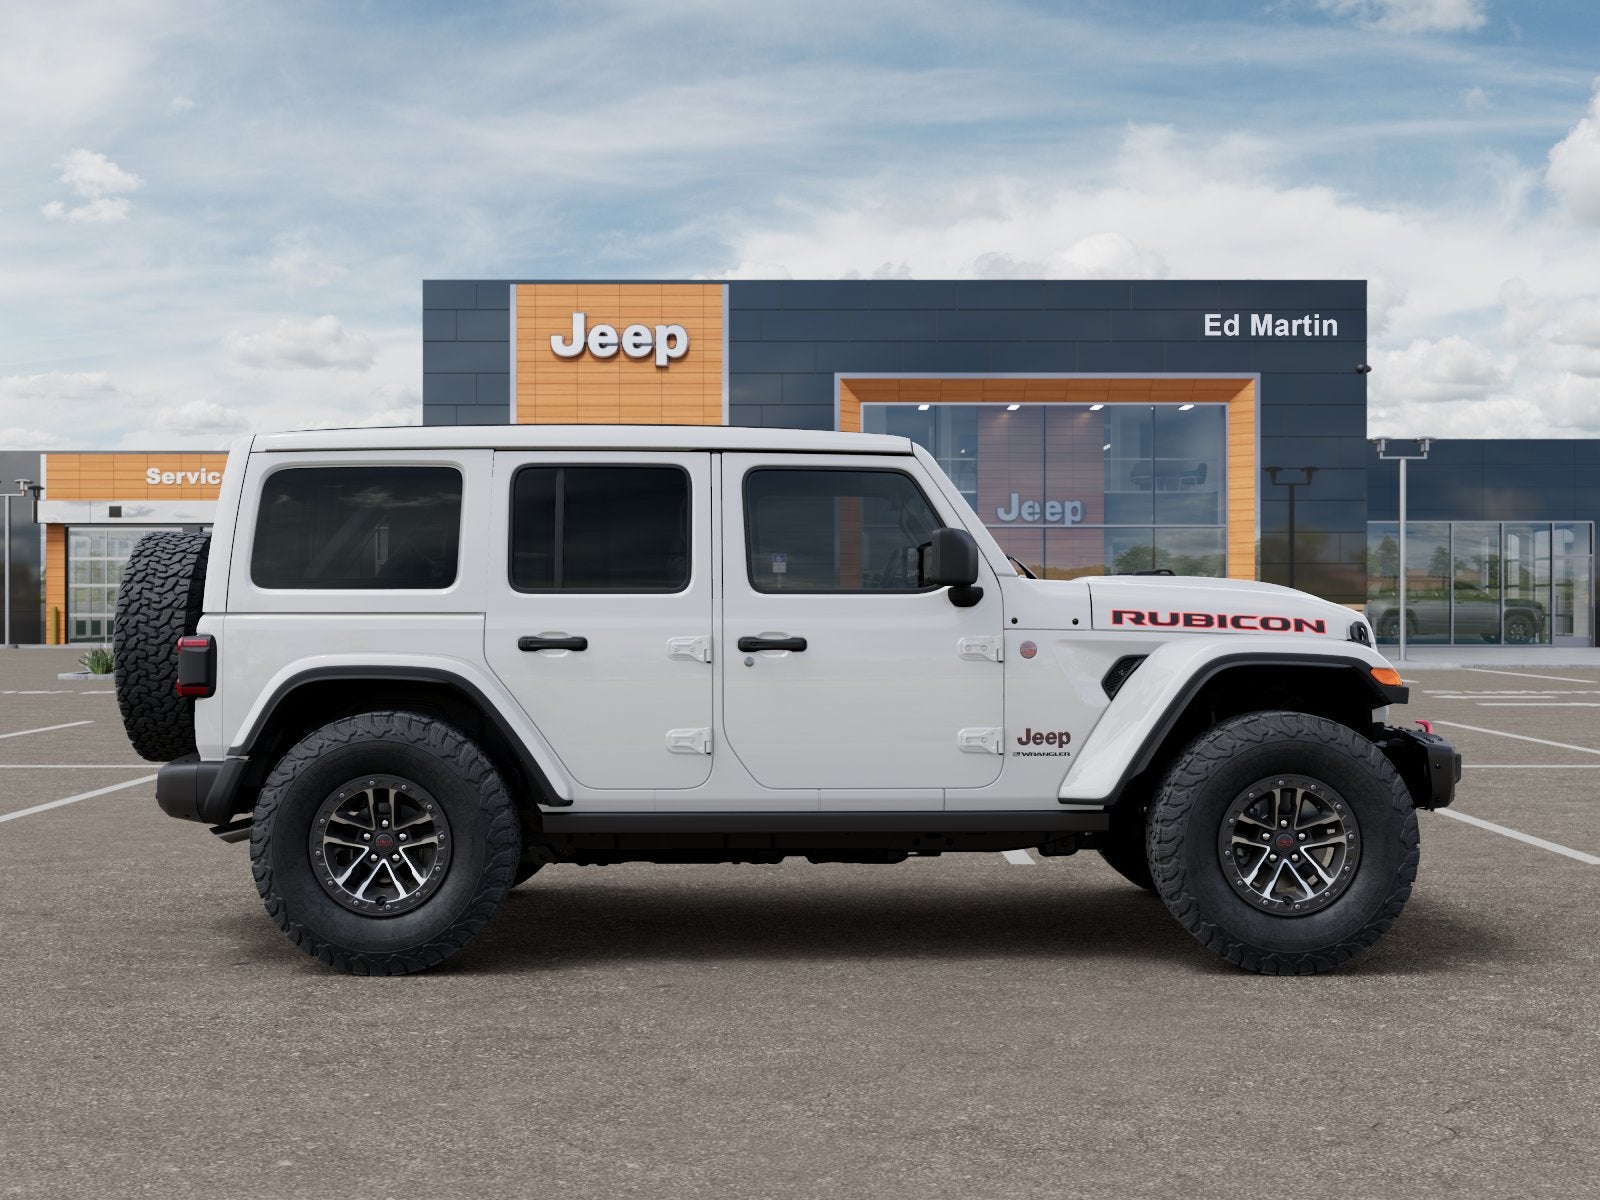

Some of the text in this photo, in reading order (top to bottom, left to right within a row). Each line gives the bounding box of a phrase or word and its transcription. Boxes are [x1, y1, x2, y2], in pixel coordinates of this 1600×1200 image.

[1204, 313, 1338, 337] Ed Martin
[550, 312, 690, 368] Jeep
[146, 467, 223, 485] Servic
[996, 493, 1084, 527] Jeep
[1111, 609, 1327, 634] RUBICON
[1017, 727, 1072, 749] Jeep
